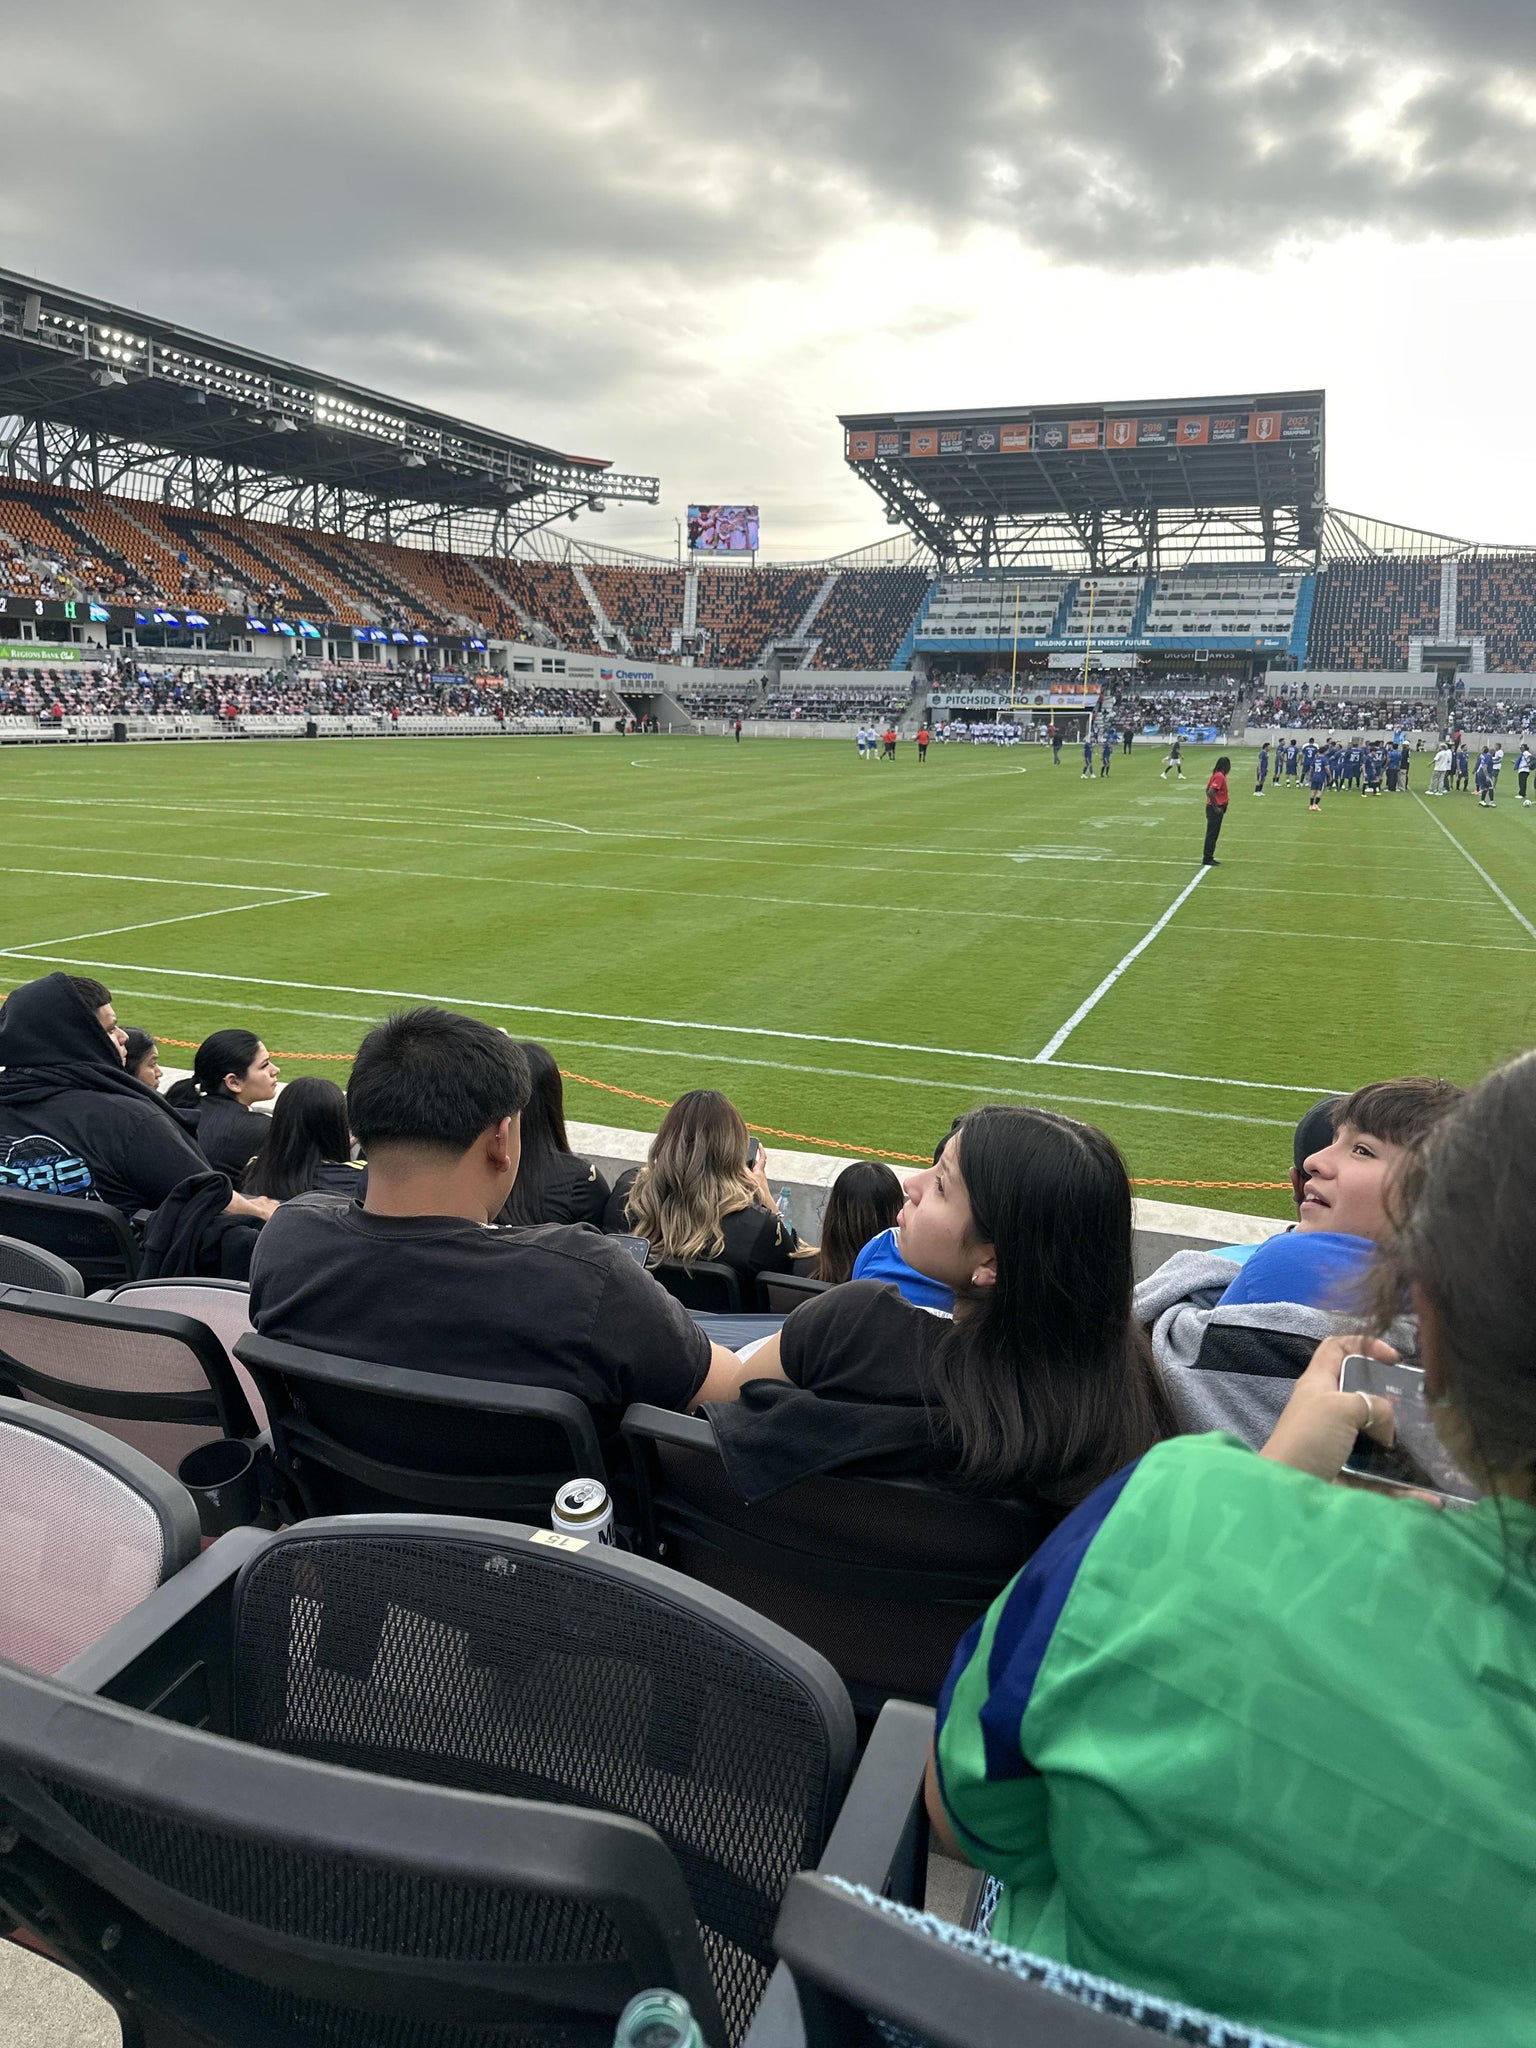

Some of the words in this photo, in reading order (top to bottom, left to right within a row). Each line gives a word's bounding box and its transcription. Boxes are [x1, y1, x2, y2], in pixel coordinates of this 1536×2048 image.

[35, 600, 44, 615] 3
[64, 601, 77, 619] H
[60, 651, 75, 660] Club
[615, 670, 654, 679] Chevron
[945, 695, 996, 705] PITCHSIDE
[545, 1534, 569, 1546] 15
